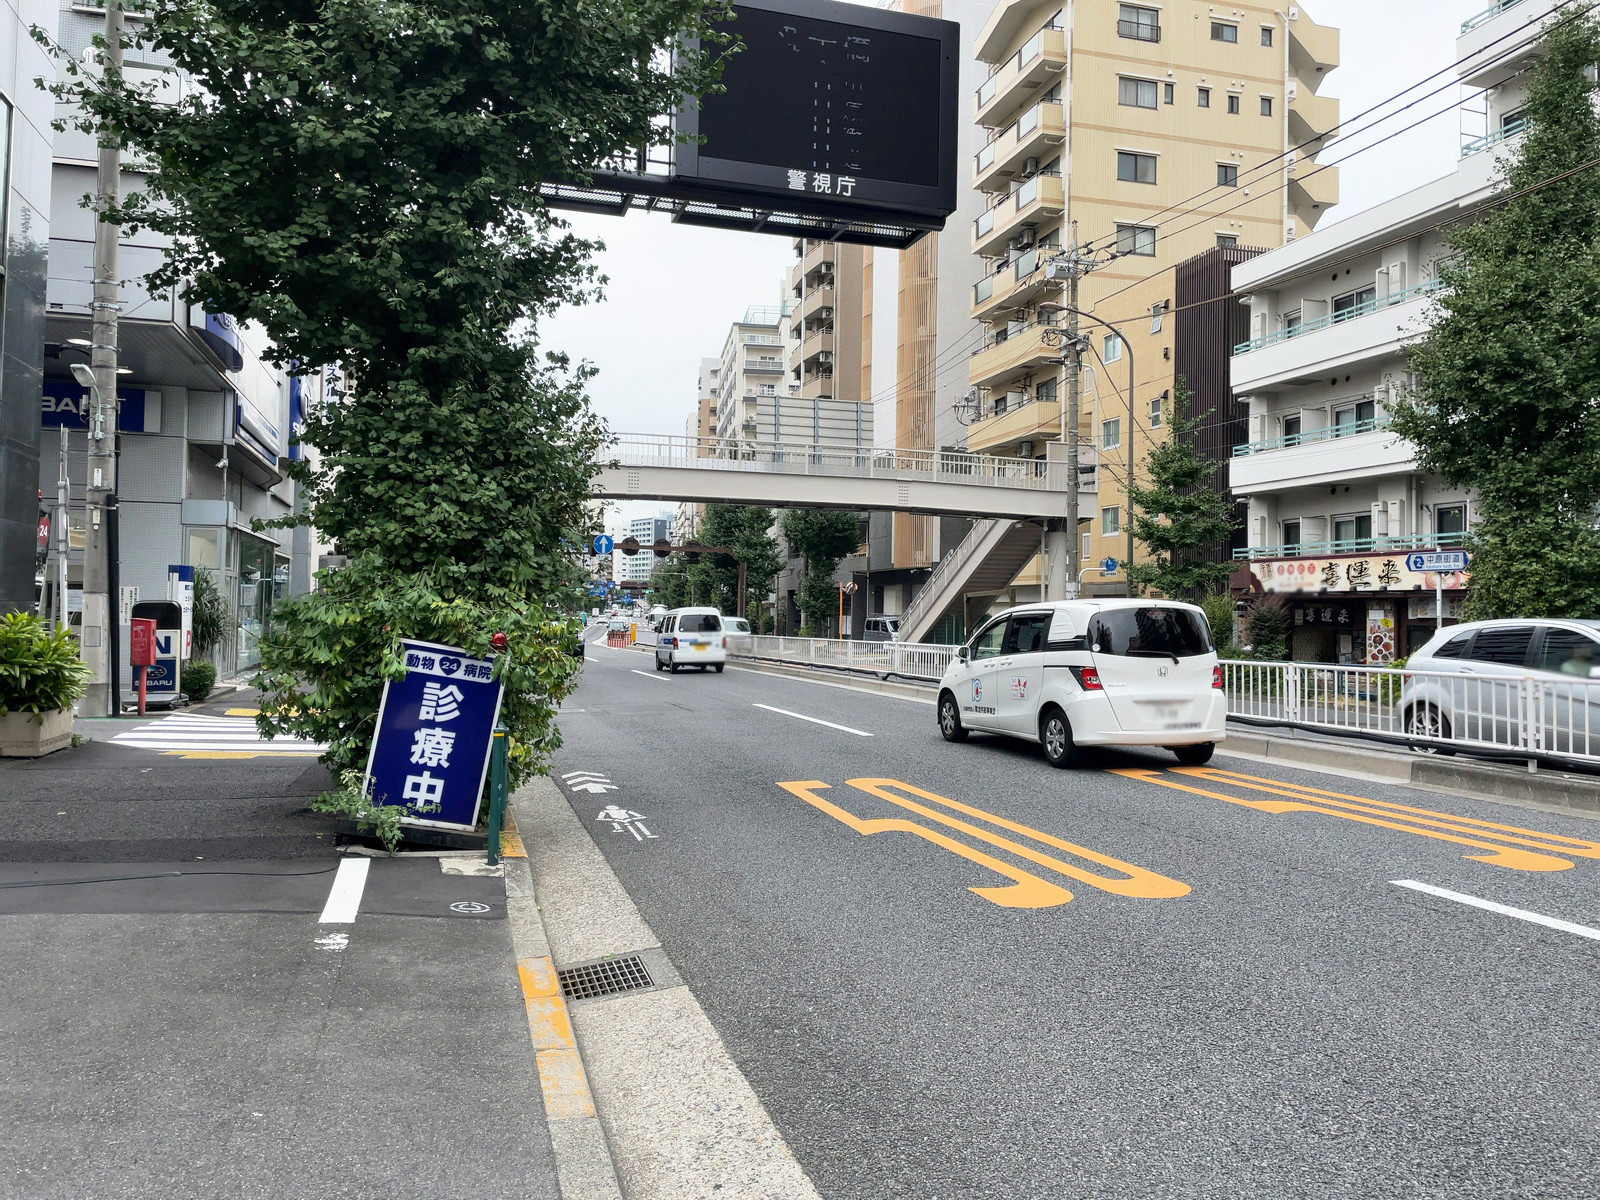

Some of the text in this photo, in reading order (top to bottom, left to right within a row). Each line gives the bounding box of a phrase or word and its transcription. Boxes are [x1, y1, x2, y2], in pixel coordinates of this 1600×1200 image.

[787, 169, 856, 197] 警視庁
[1427, 554, 1460, 564] 中原街道
[406, 653, 492, 680] 動物 24 病院
[402, 681, 465, 809] 診療中
